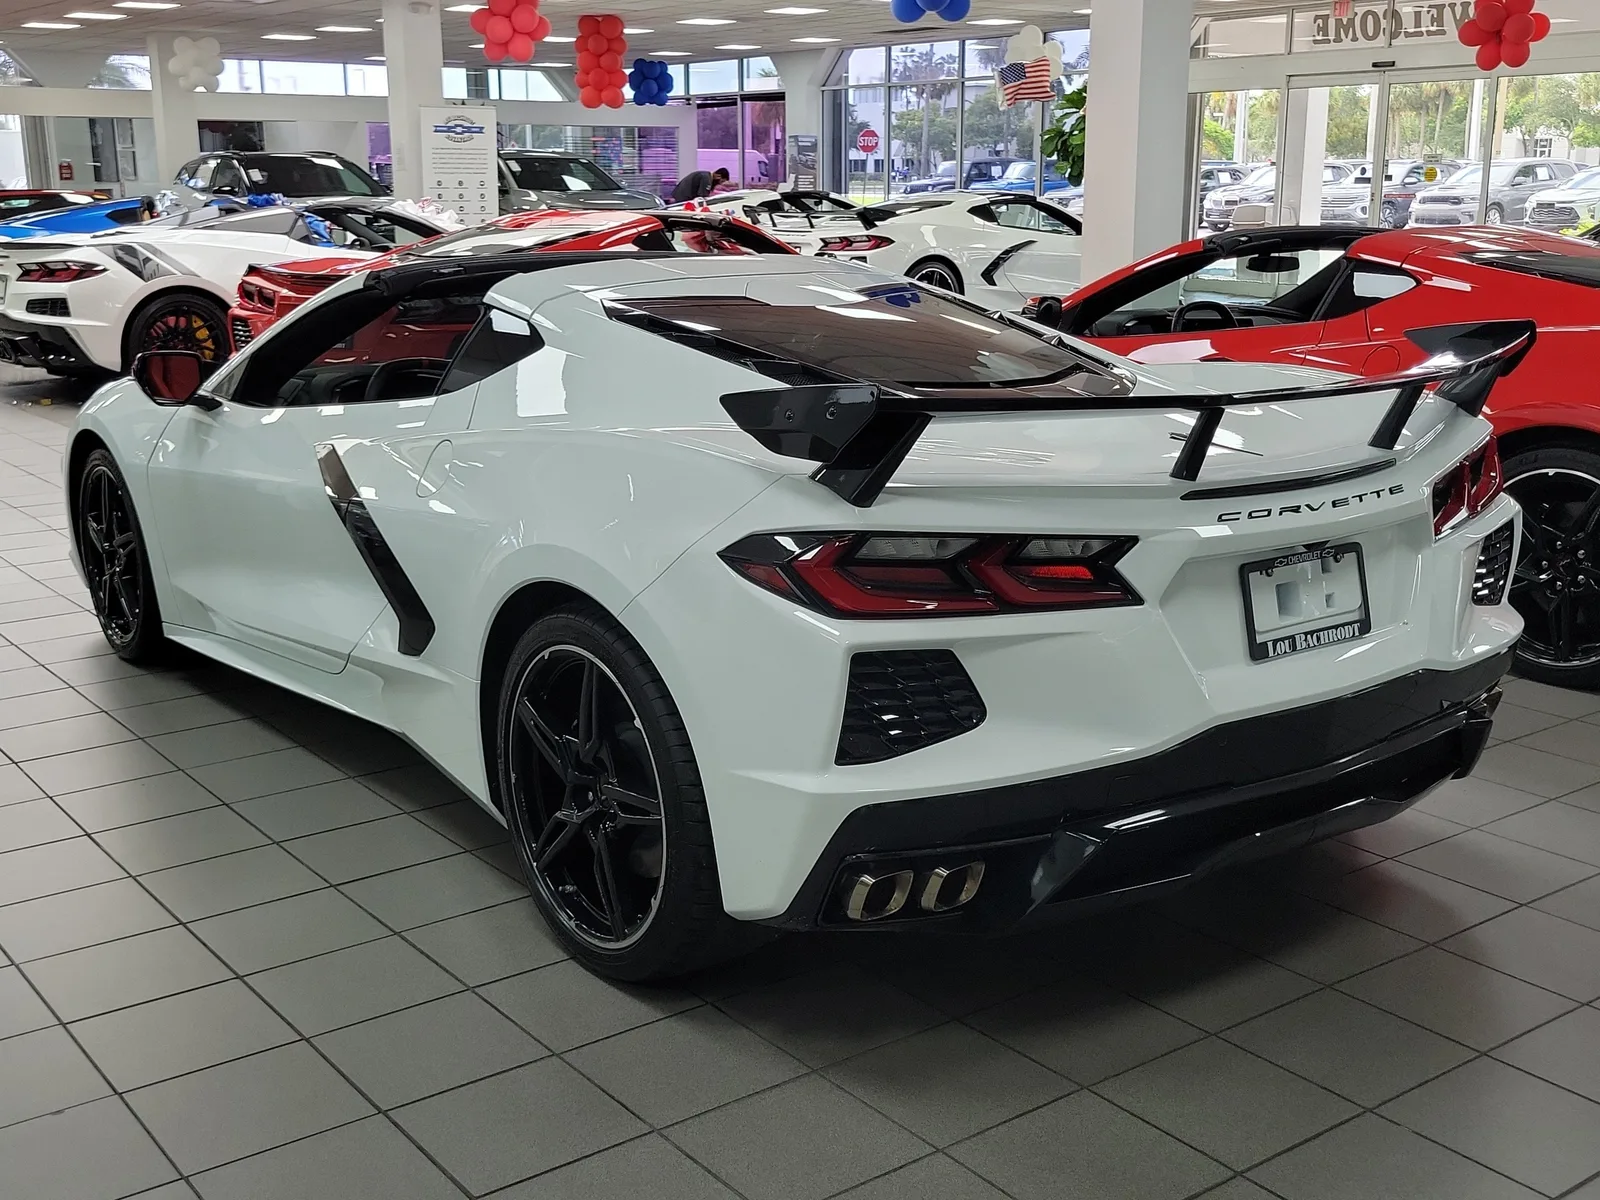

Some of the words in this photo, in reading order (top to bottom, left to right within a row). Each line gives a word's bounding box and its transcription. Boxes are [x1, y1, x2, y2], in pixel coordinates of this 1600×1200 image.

[859, 136, 878, 147] STOP
[1217, 483, 1405, 523] CORVETTE
[1288, 550, 1321, 565] CHEVROLET
